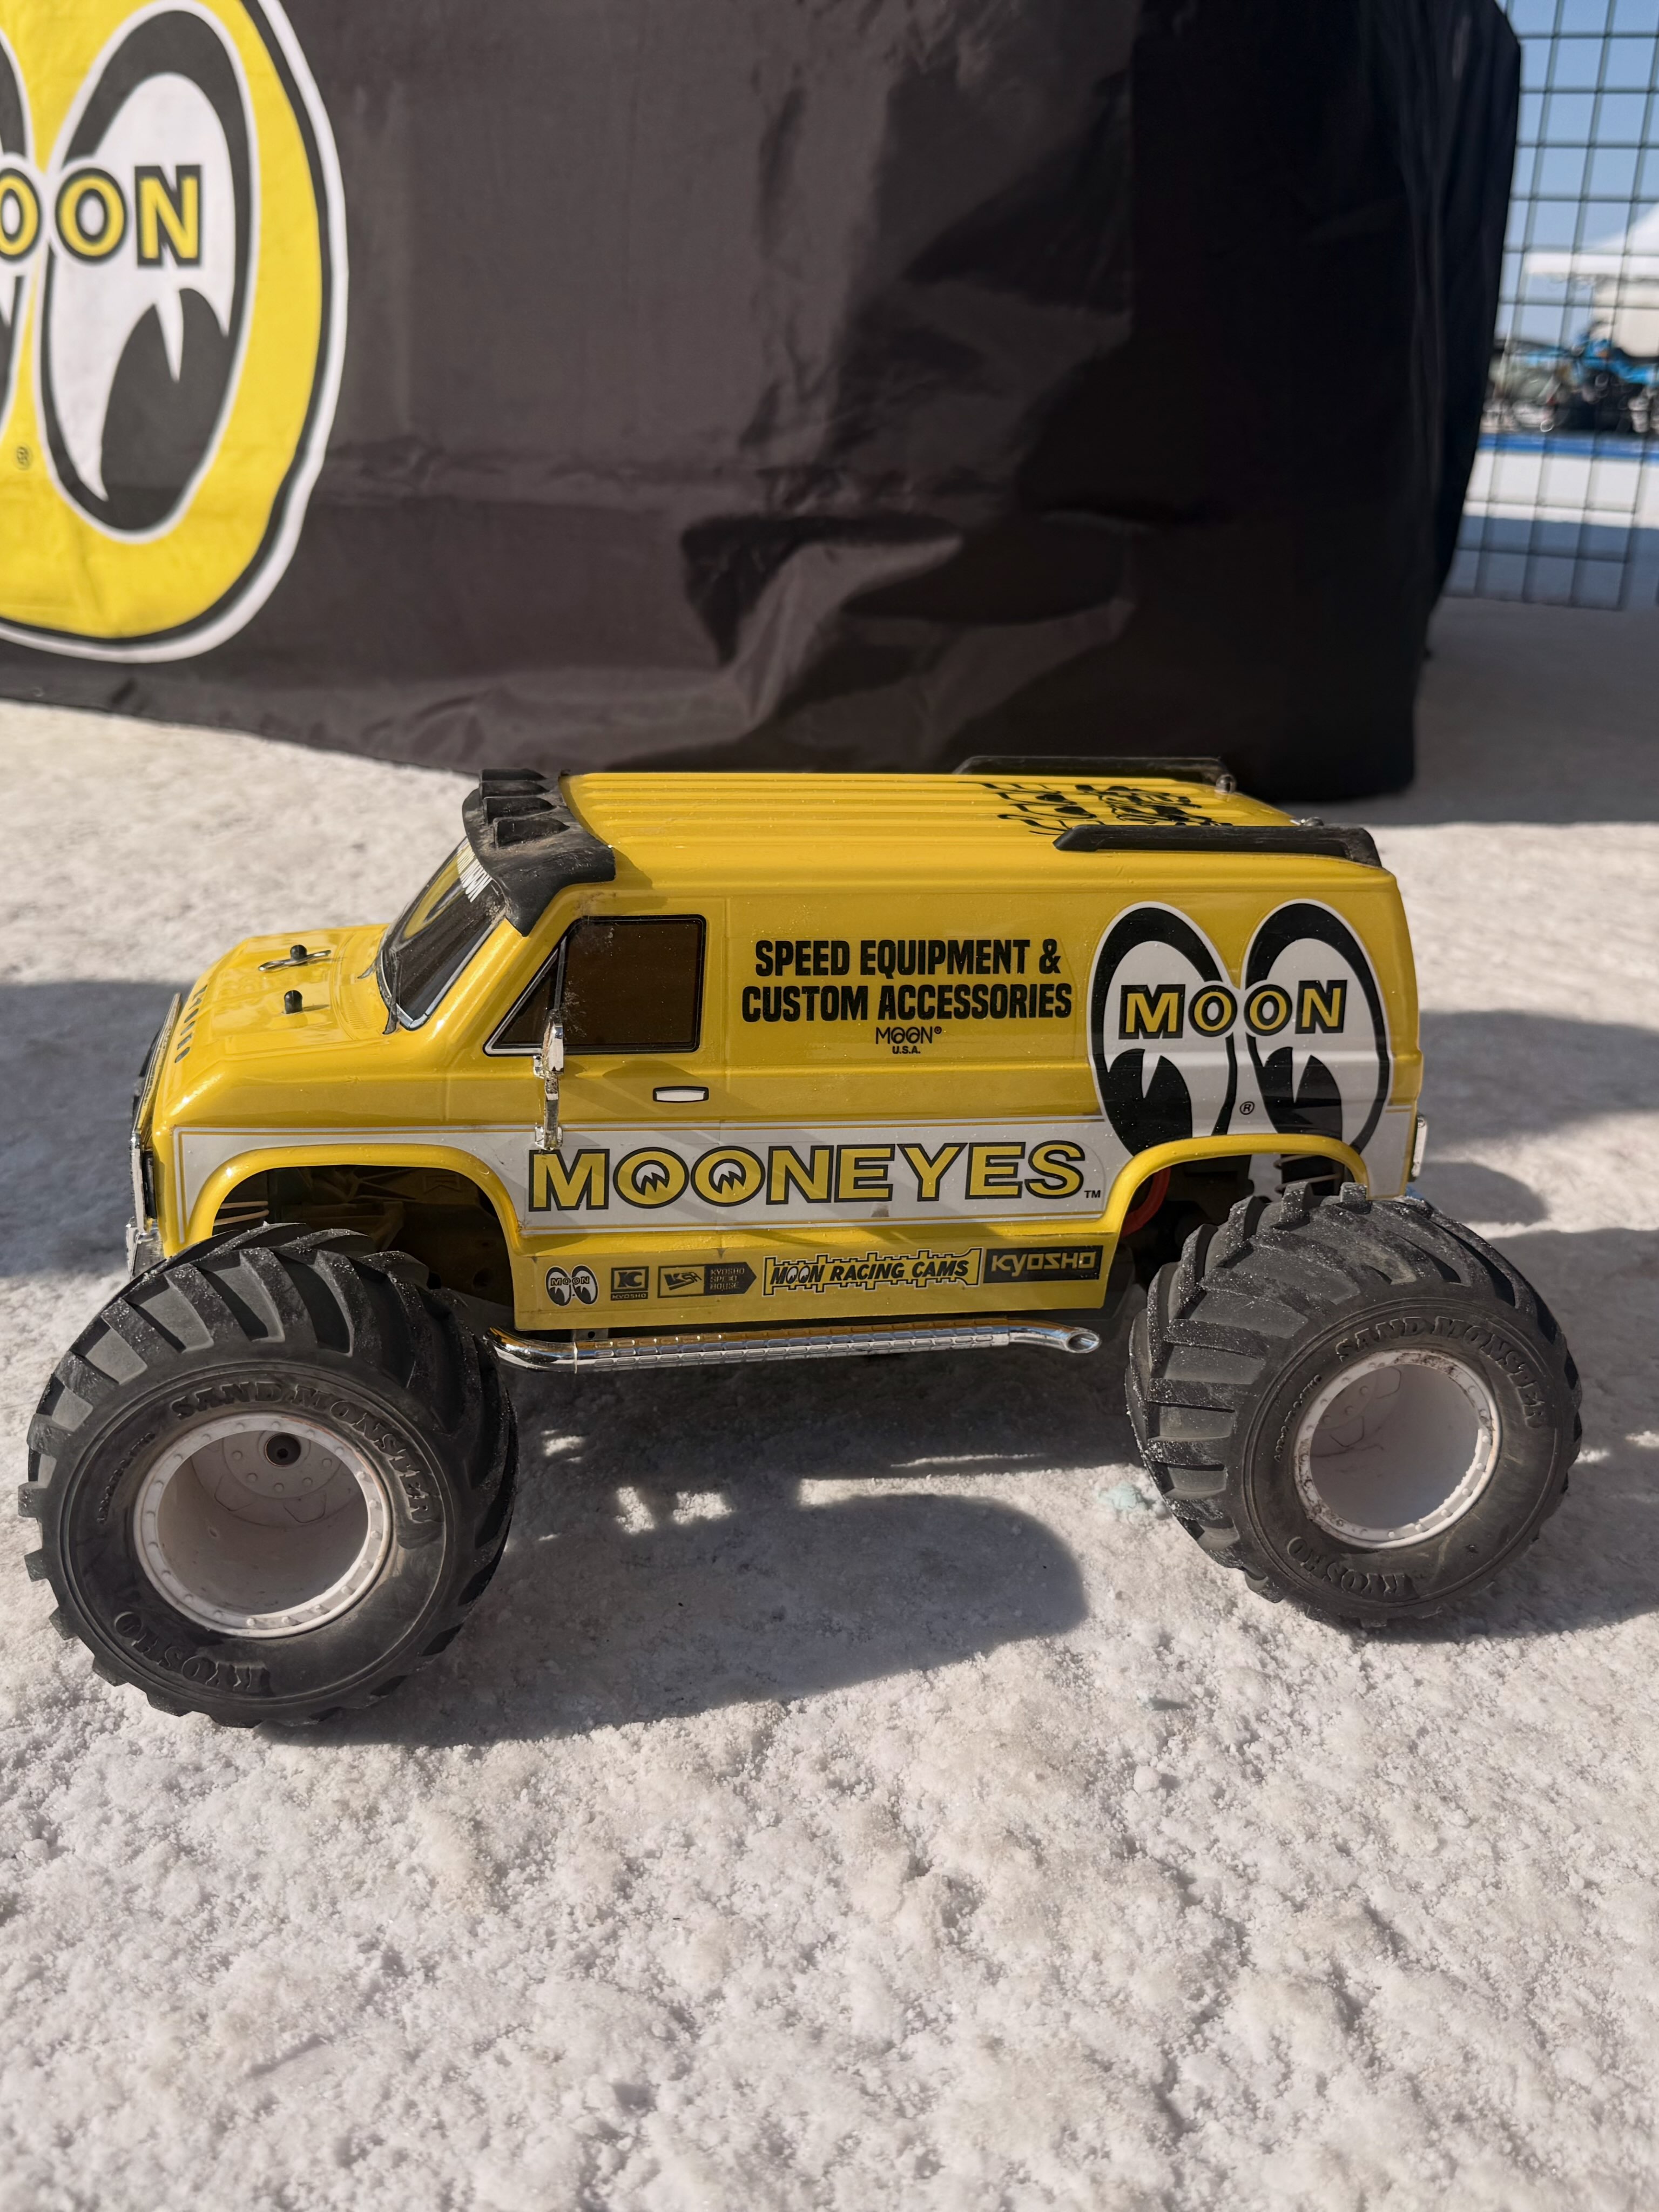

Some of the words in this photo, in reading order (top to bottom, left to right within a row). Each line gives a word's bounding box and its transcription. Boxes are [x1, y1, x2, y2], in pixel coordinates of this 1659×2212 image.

[756, 940, 850, 976] SPEED
[860, 939, 1030, 979] EQUIPMENT
[1039, 939, 1061, 974] &
[742, 986, 868, 1022] CUSTOM
[878, 983, 1072, 1020] ACCESSORIES
[1118, 980, 1347, 1039] MOON
[892, 1046, 921, 1054] U.S.A.
[529, 1140, 1086, 1211] MOONEYES
[550, 1276, 590, 1286] MOON
[770, 1265, 824, 1285] MOON
[830, 1262, 905, 1282] RACING
[912, 1260, 969, 1278] CAMS
[1335, 1316, 1429, 1363] SAND
[1432, 1316, 1547, 1429] MONSTER
[170, 1381, 284, 1420] SAND
[289, 1384, 435, 1522] MONSTER
[1287, 1536, 1420, 1601] KYOSHO
[113, 1611, 274, 1696] KYOSHO
